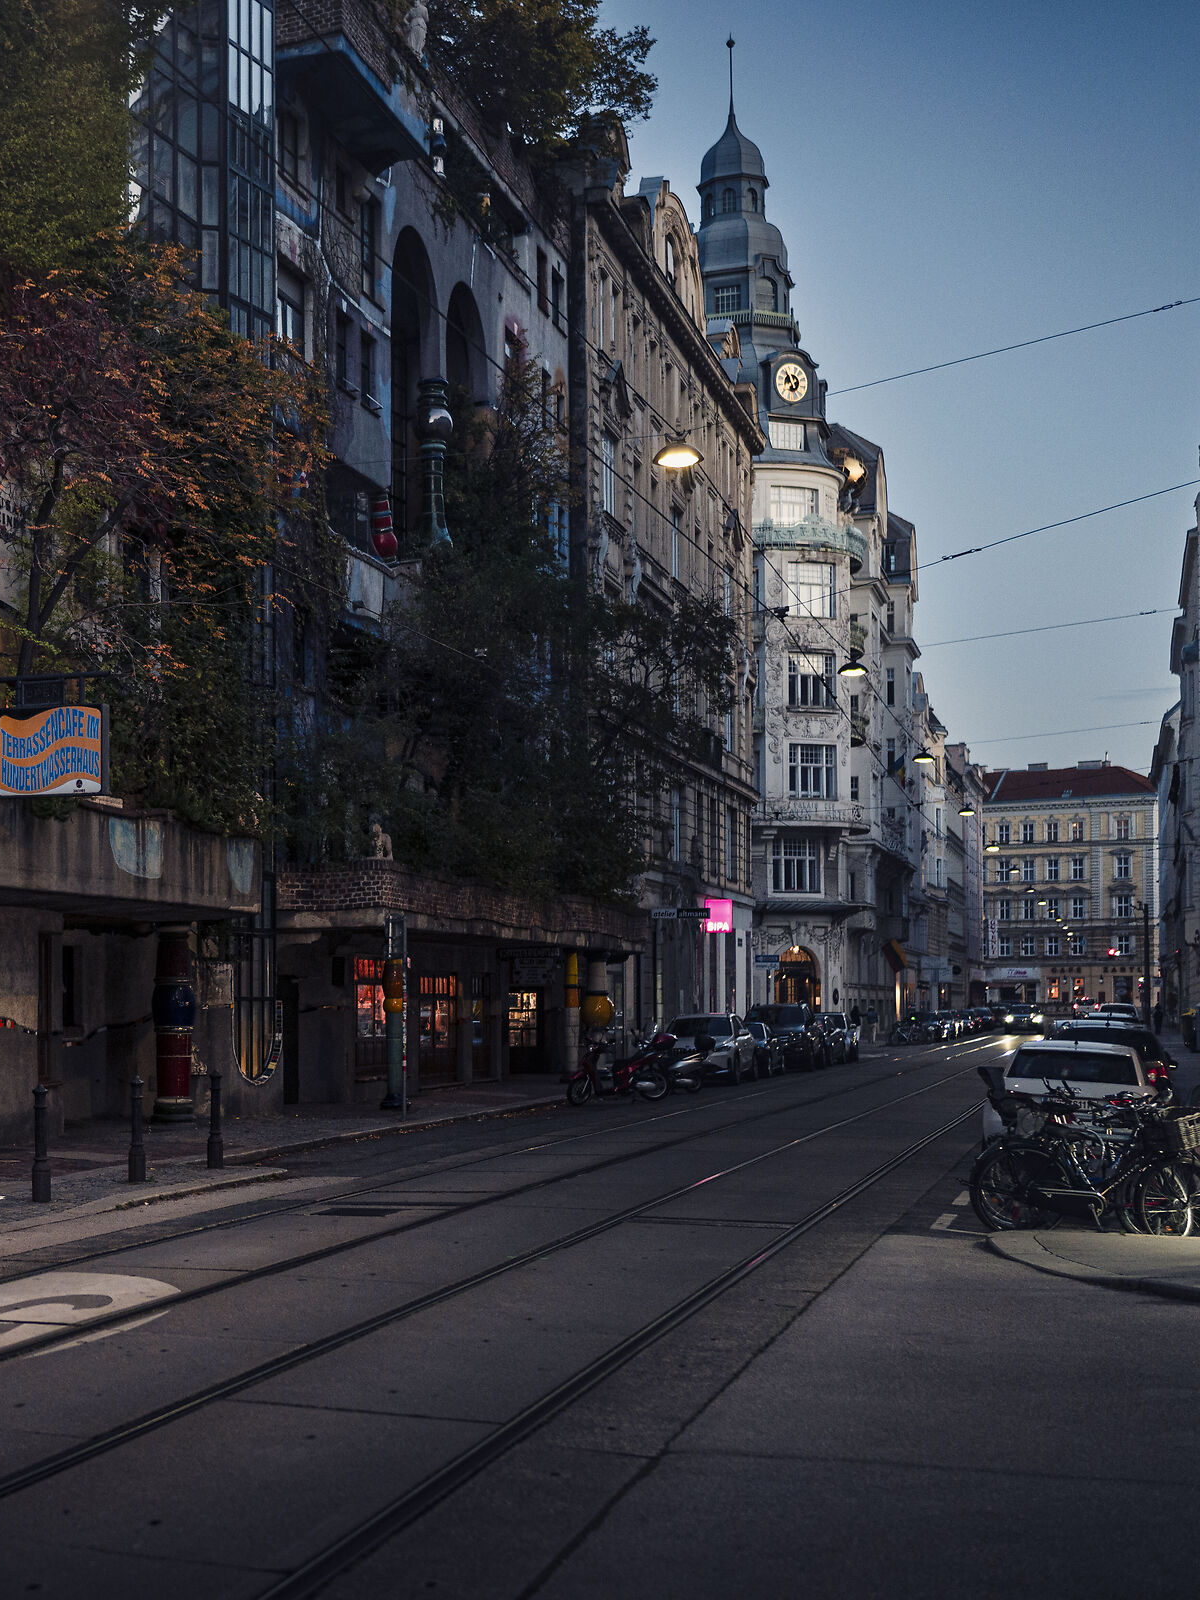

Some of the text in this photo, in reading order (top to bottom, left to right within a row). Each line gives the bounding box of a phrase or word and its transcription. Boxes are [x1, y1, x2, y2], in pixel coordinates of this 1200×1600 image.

[0, 708, 100, 759] TERRASSENCAFE IM
[1, 746, 100, 792] HUNDERTWASSERHAUS
[653, 909, 708, 918] atelier altmann
[706, 921, 730, 932] BIPA
